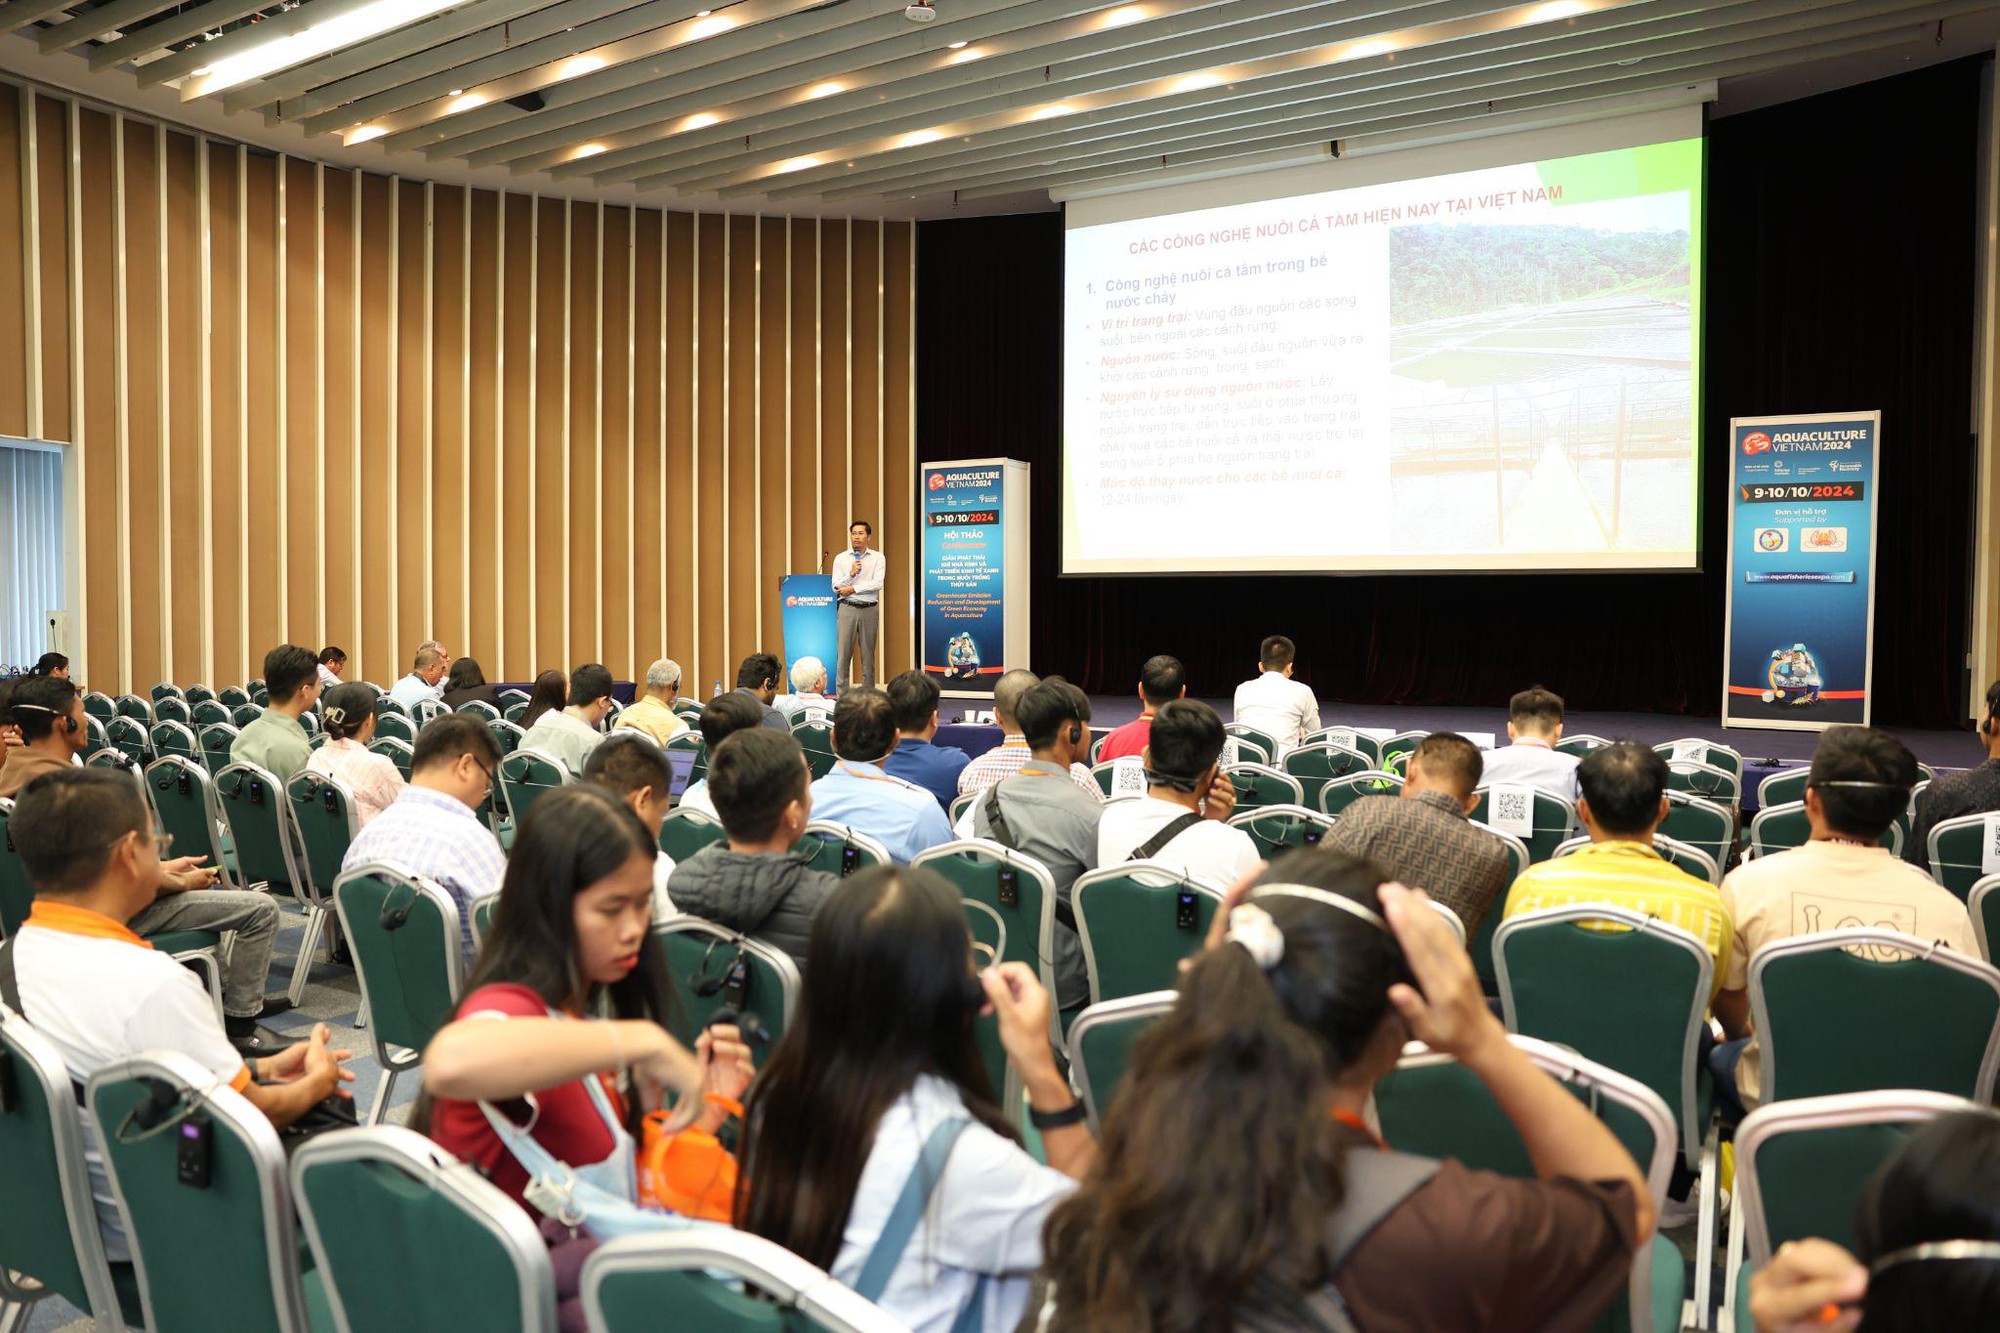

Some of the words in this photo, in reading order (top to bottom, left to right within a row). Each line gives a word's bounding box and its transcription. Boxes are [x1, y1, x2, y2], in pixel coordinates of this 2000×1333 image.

[1408, 201, 1441, 218] NAY
[1445, 197, 1473, 215] TẠI
[1522, 184, 1563, 204] NAM
[1266, 260, 1305, 273] trong
[1772, 429, 1867, 443] AQUACULTURE
[946, 471, 999, 482] AQUACULTURE
